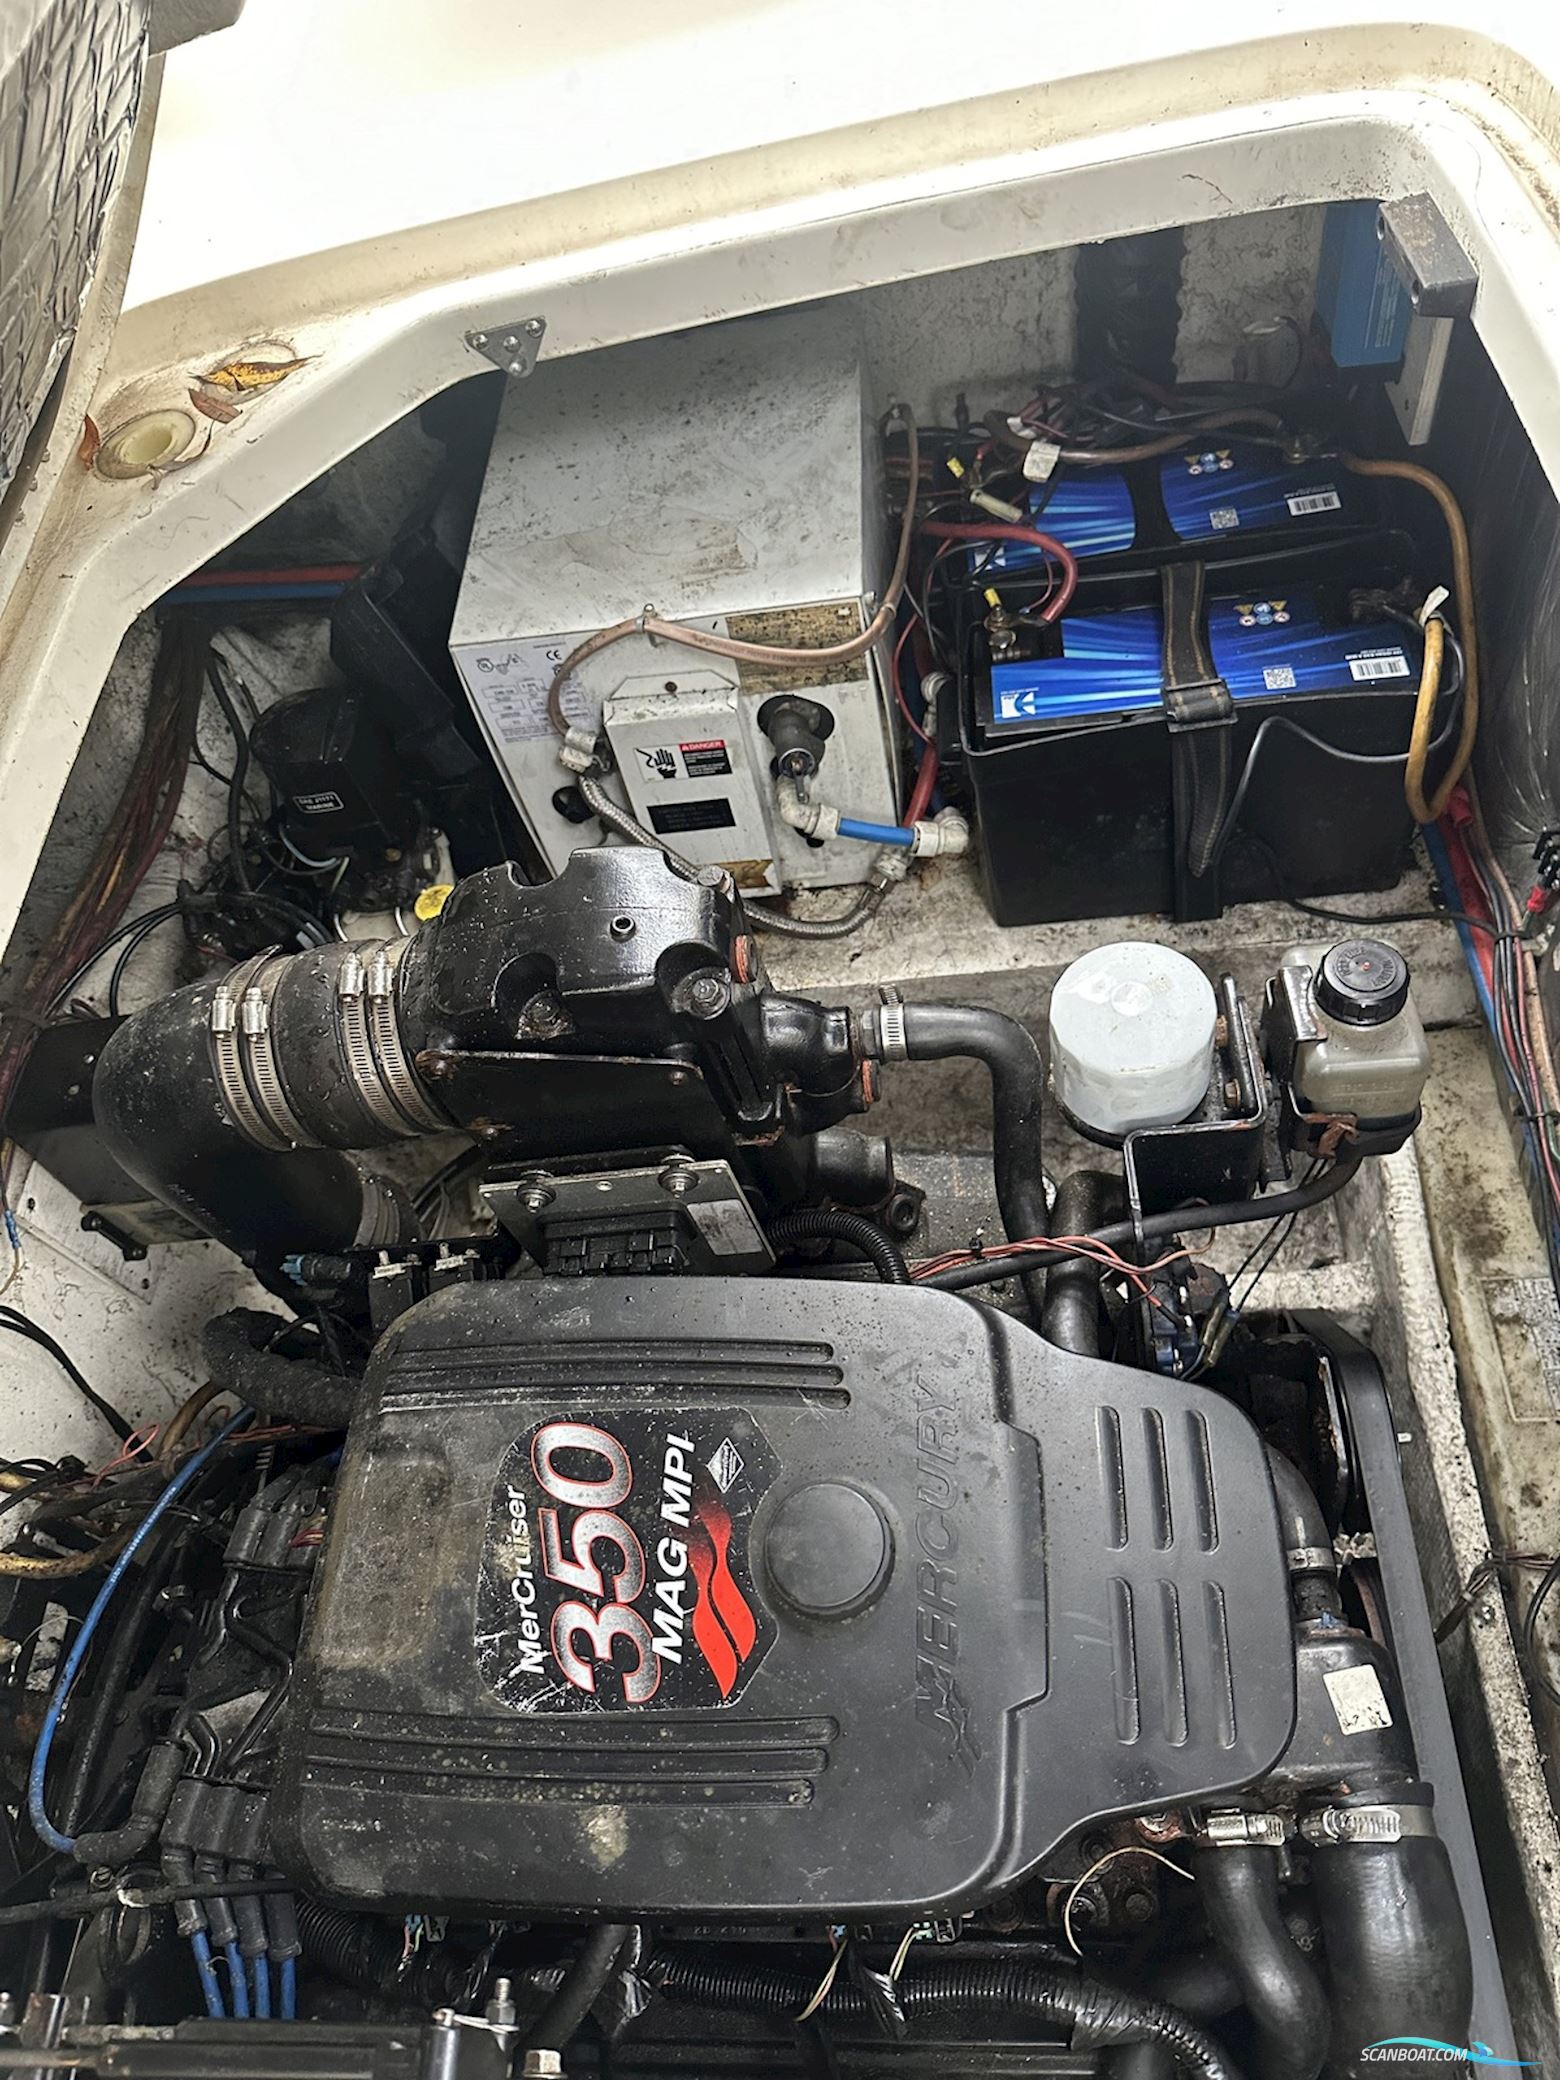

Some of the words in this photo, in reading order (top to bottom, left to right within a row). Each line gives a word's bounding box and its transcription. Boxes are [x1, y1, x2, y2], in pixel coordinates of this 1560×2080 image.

[689, 741, 721, 750] DANGER
[662, 1432, 697, 1528] MPI
[916, 1374, 959, 1736] MERCURY
[508, 1484, 546, 1676] MerCruiser
[530, 1421, 662, 1704] 350
[651, 1537, 690, 1665] MAG
